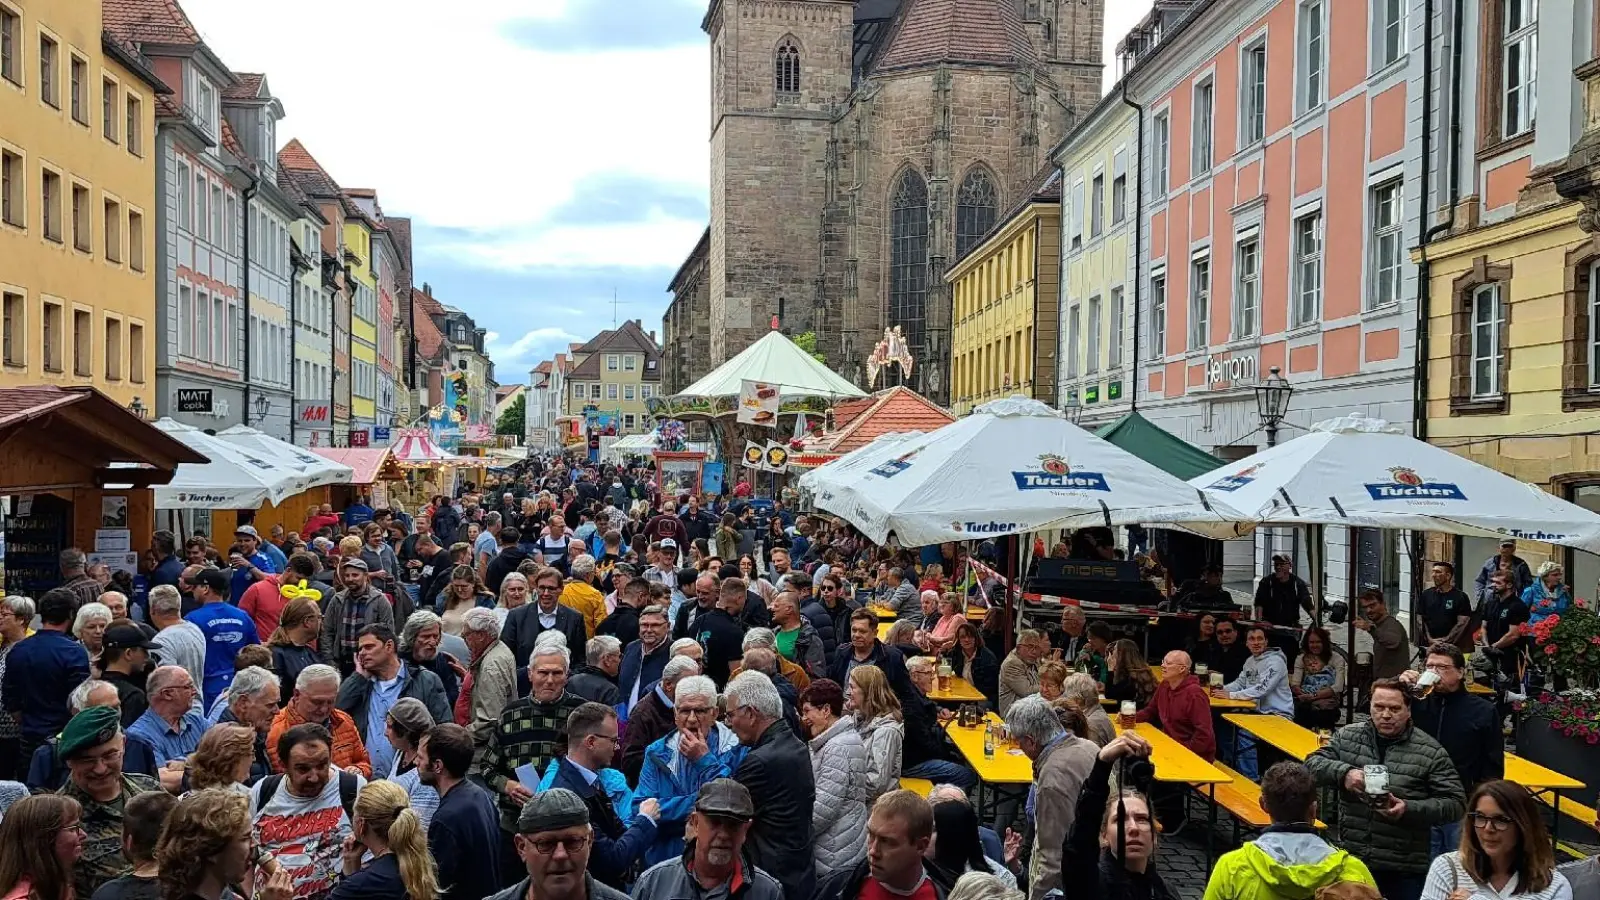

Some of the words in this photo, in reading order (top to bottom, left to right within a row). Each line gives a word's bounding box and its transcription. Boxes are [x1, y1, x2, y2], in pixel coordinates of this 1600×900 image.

[1207, 355, 1256, 384] fielmann
[180, 390, 210, 401] MATT
[354, 432, 365, 444] T
[1024, 474, 1100, 487] Tucher
[1375, 485, 1455, 497] Tucher
[188, 493, 226, 502] Tucher
[964, 520, 1017, 533] Tucher
[1510, 529, 1566, 540] Tucher
